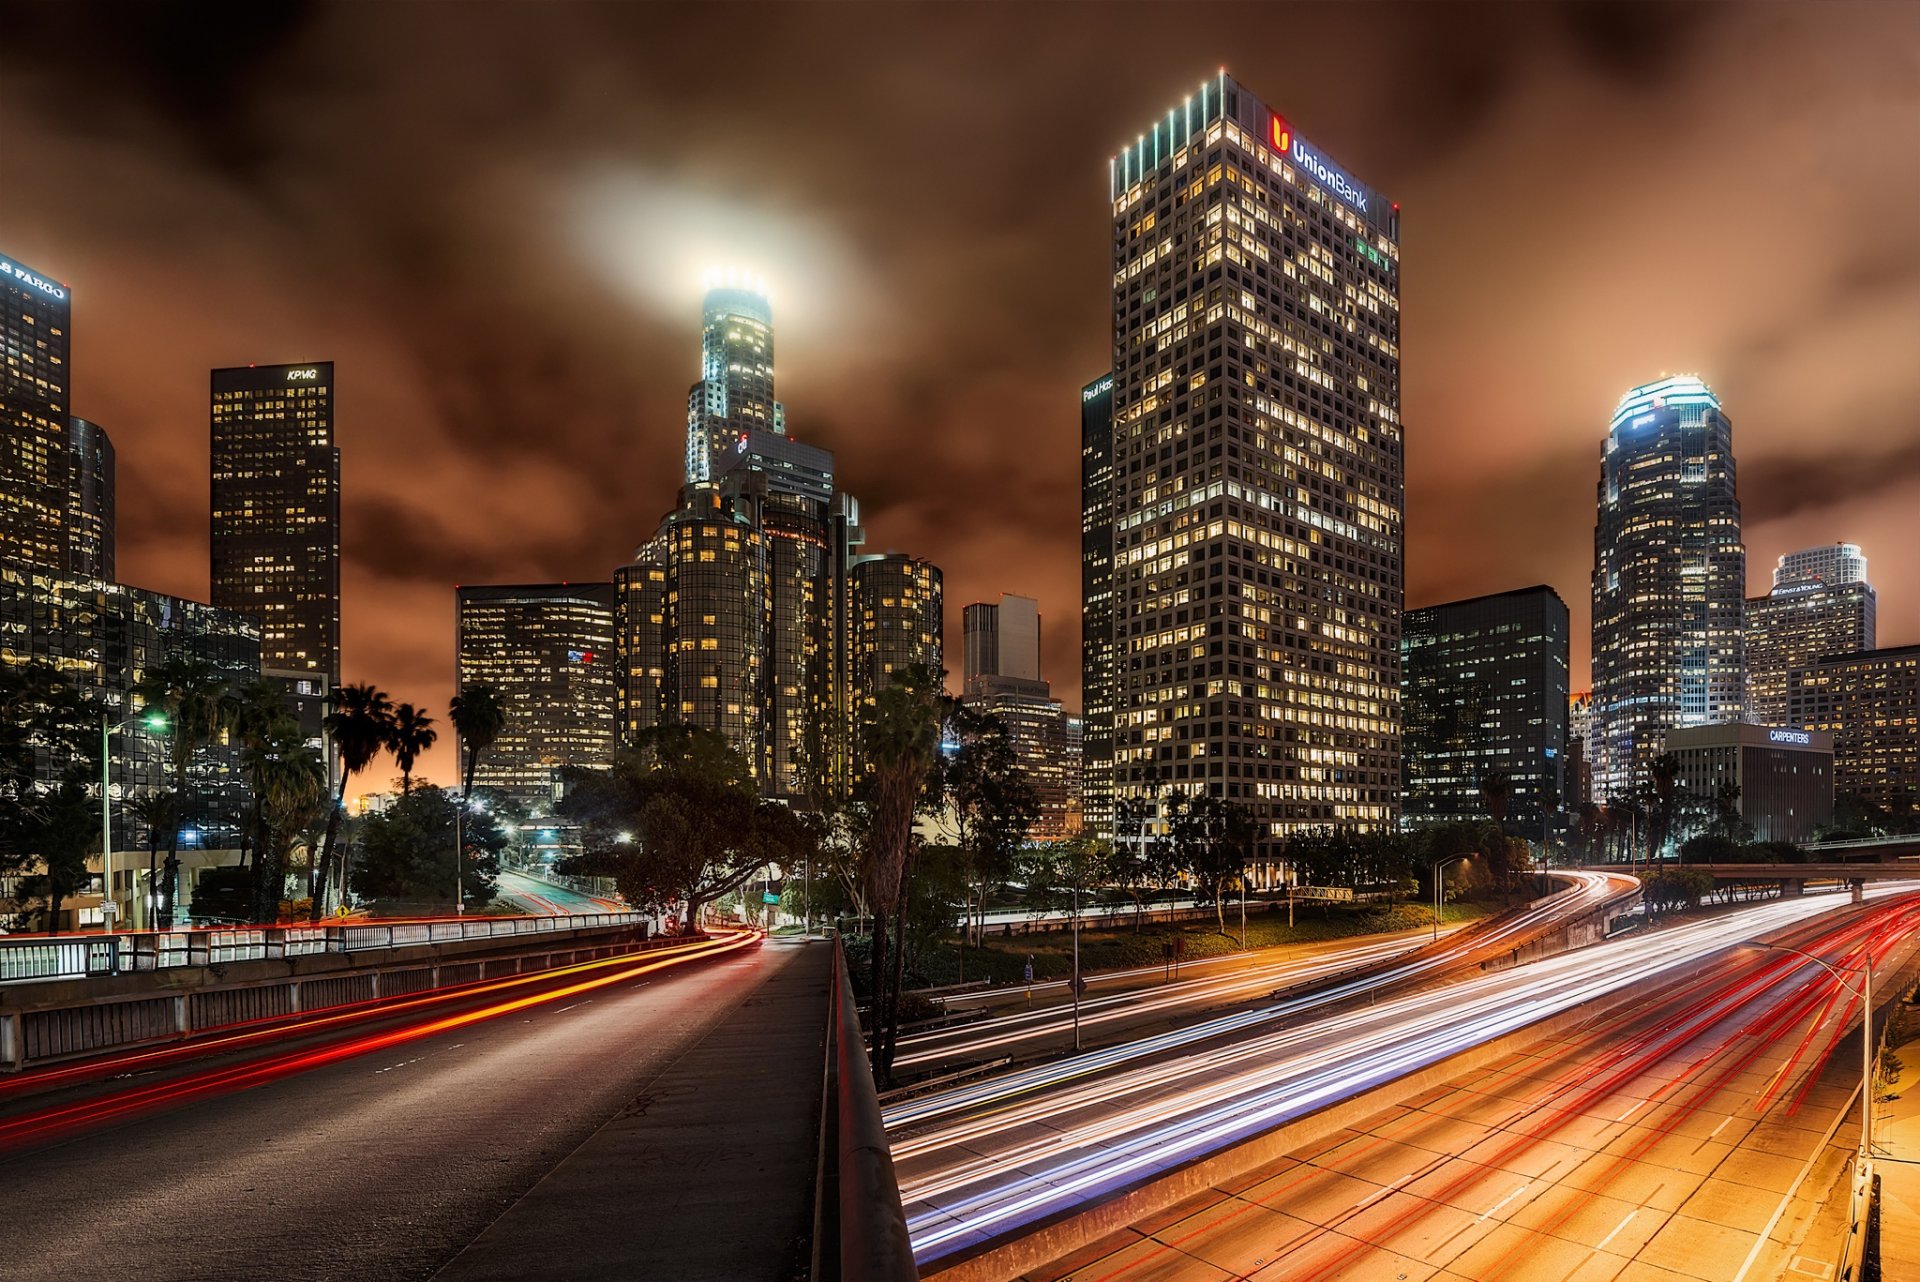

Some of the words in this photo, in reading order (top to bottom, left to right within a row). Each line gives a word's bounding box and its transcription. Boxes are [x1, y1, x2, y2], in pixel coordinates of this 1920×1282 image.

[1293, 139, 1367, 212] UnionBank
[0, 262, 12, 274] S
[14, 267, 64, 299] FARGO
[287, 369, 317, 380] KPMG
[1083, 384, 1099, 402] Paul
[1770, 730, 1809, 744] CARPENTERS
